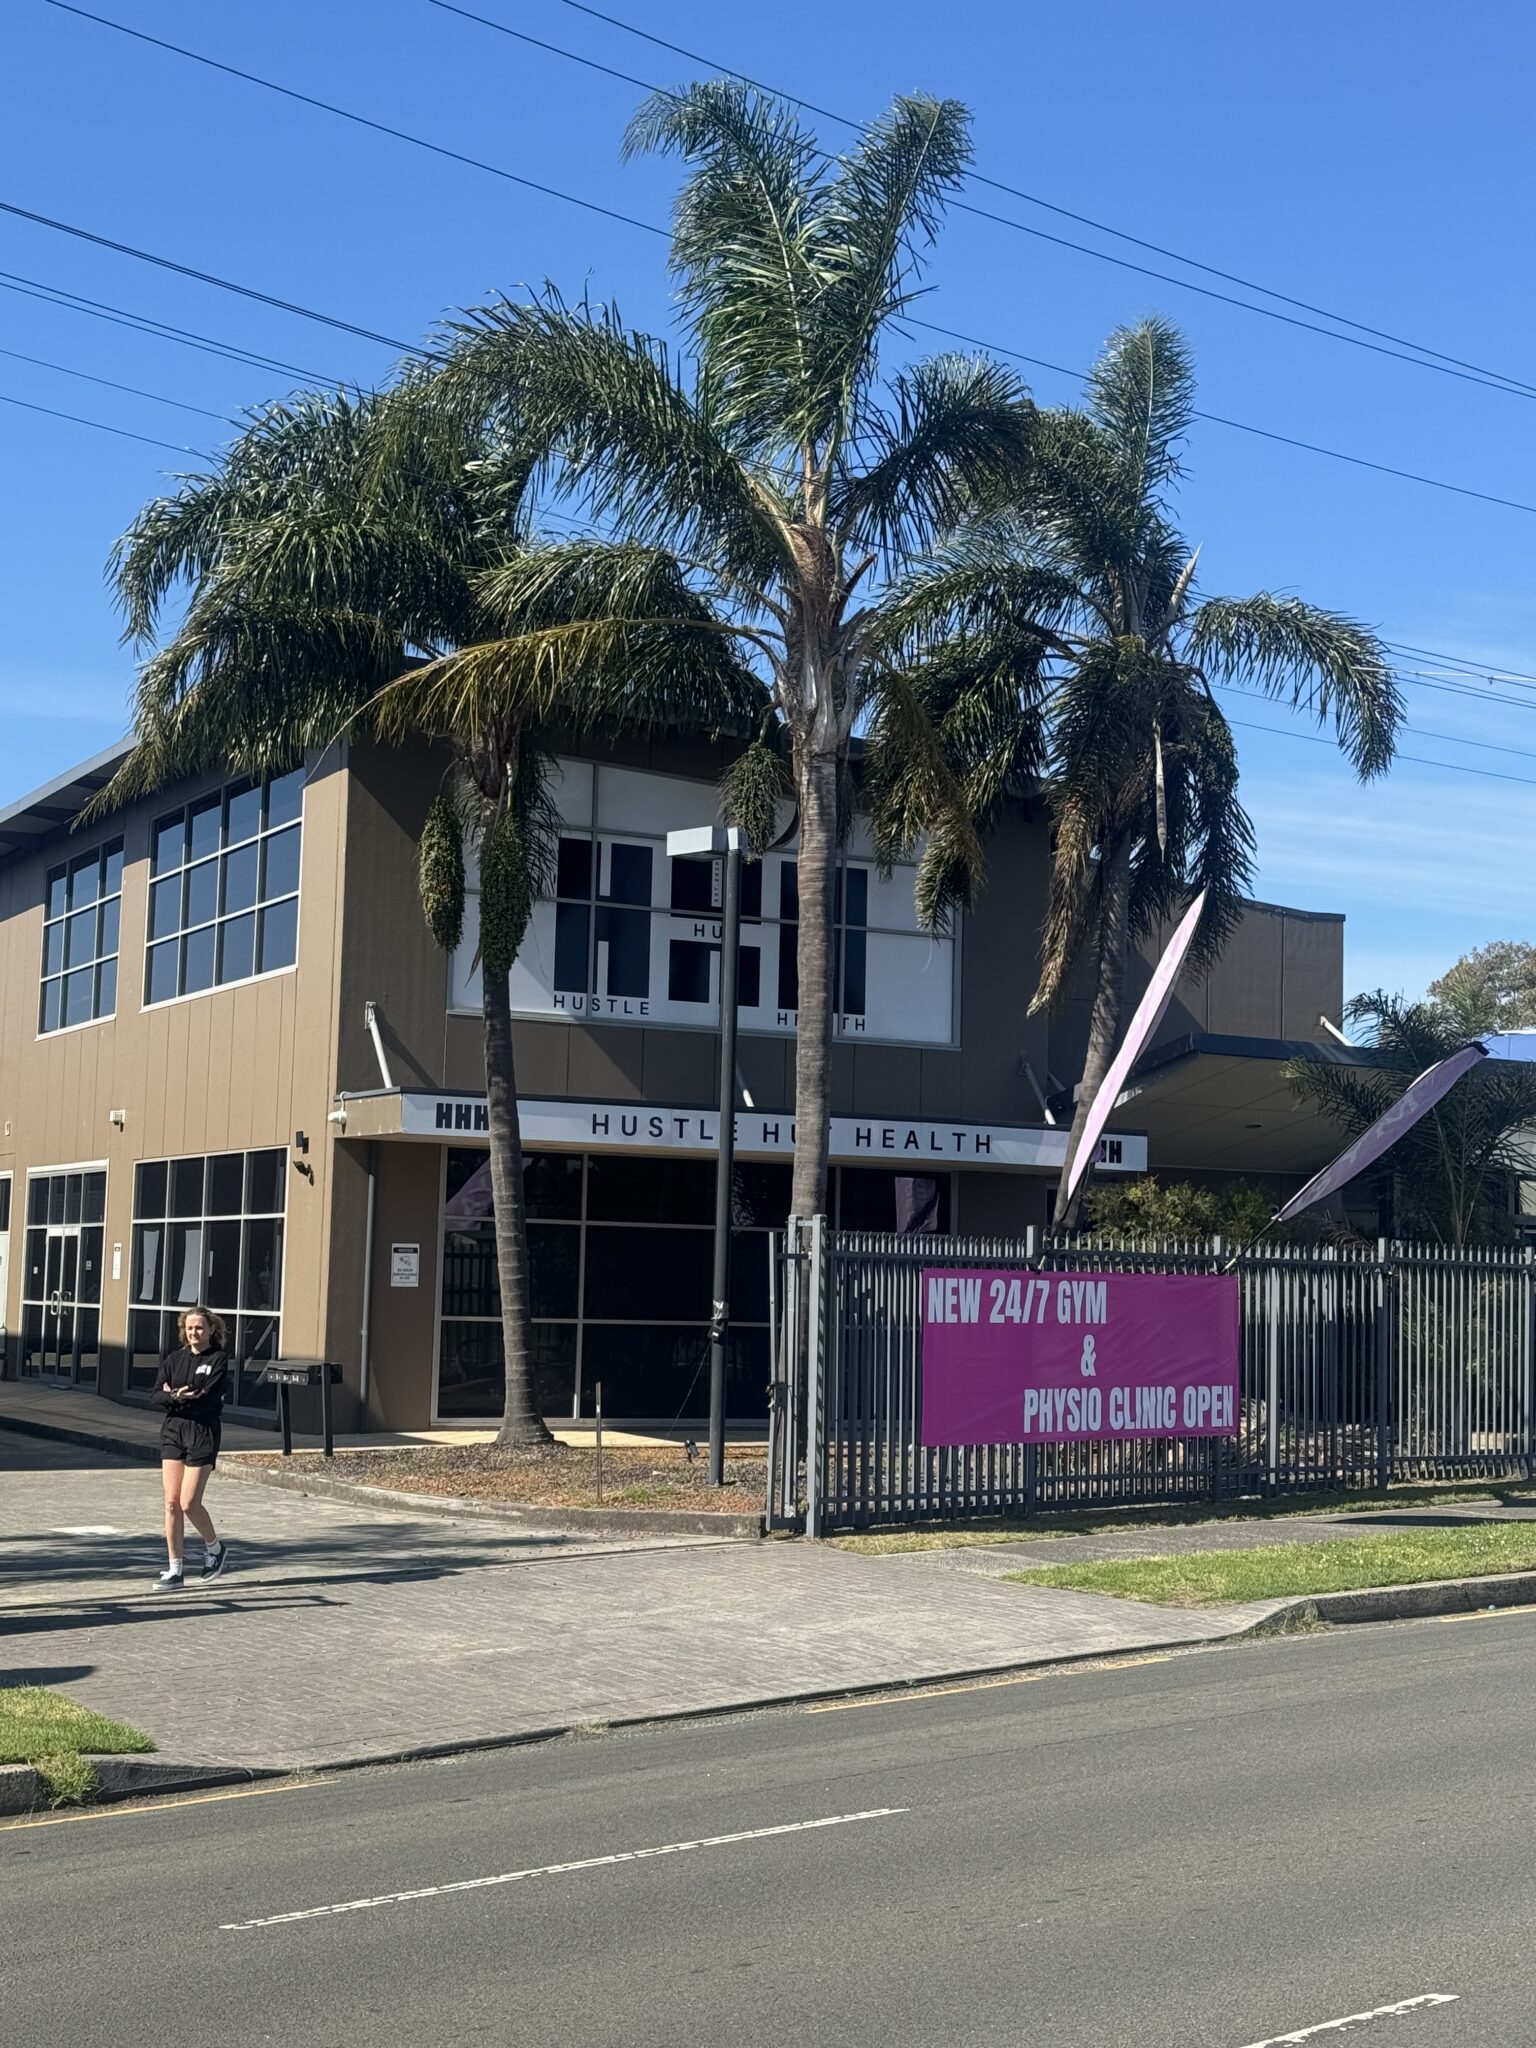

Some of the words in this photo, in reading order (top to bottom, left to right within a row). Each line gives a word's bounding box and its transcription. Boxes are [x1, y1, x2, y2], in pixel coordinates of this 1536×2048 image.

[693, 923, 722, 939] HU
[553, 994, 650, 1015] HUSTLE
[776, 1011, 866, 1032] HTH
[855, 1126, 991, 1154] HEALTH
[927, 1277, 982, 1324] NEW
[989, 1279, 1050, 1324] 24/7
[1057, 1280, 1107, 1325] GYM
[1080, 1334, 1097, 1377] &
[1023, 1387, 1102, 1434] PHYSIO
[1109, 1385, 1177, 1431] CLINIC
[1182, 1384, 1234, 1429] OPEN
